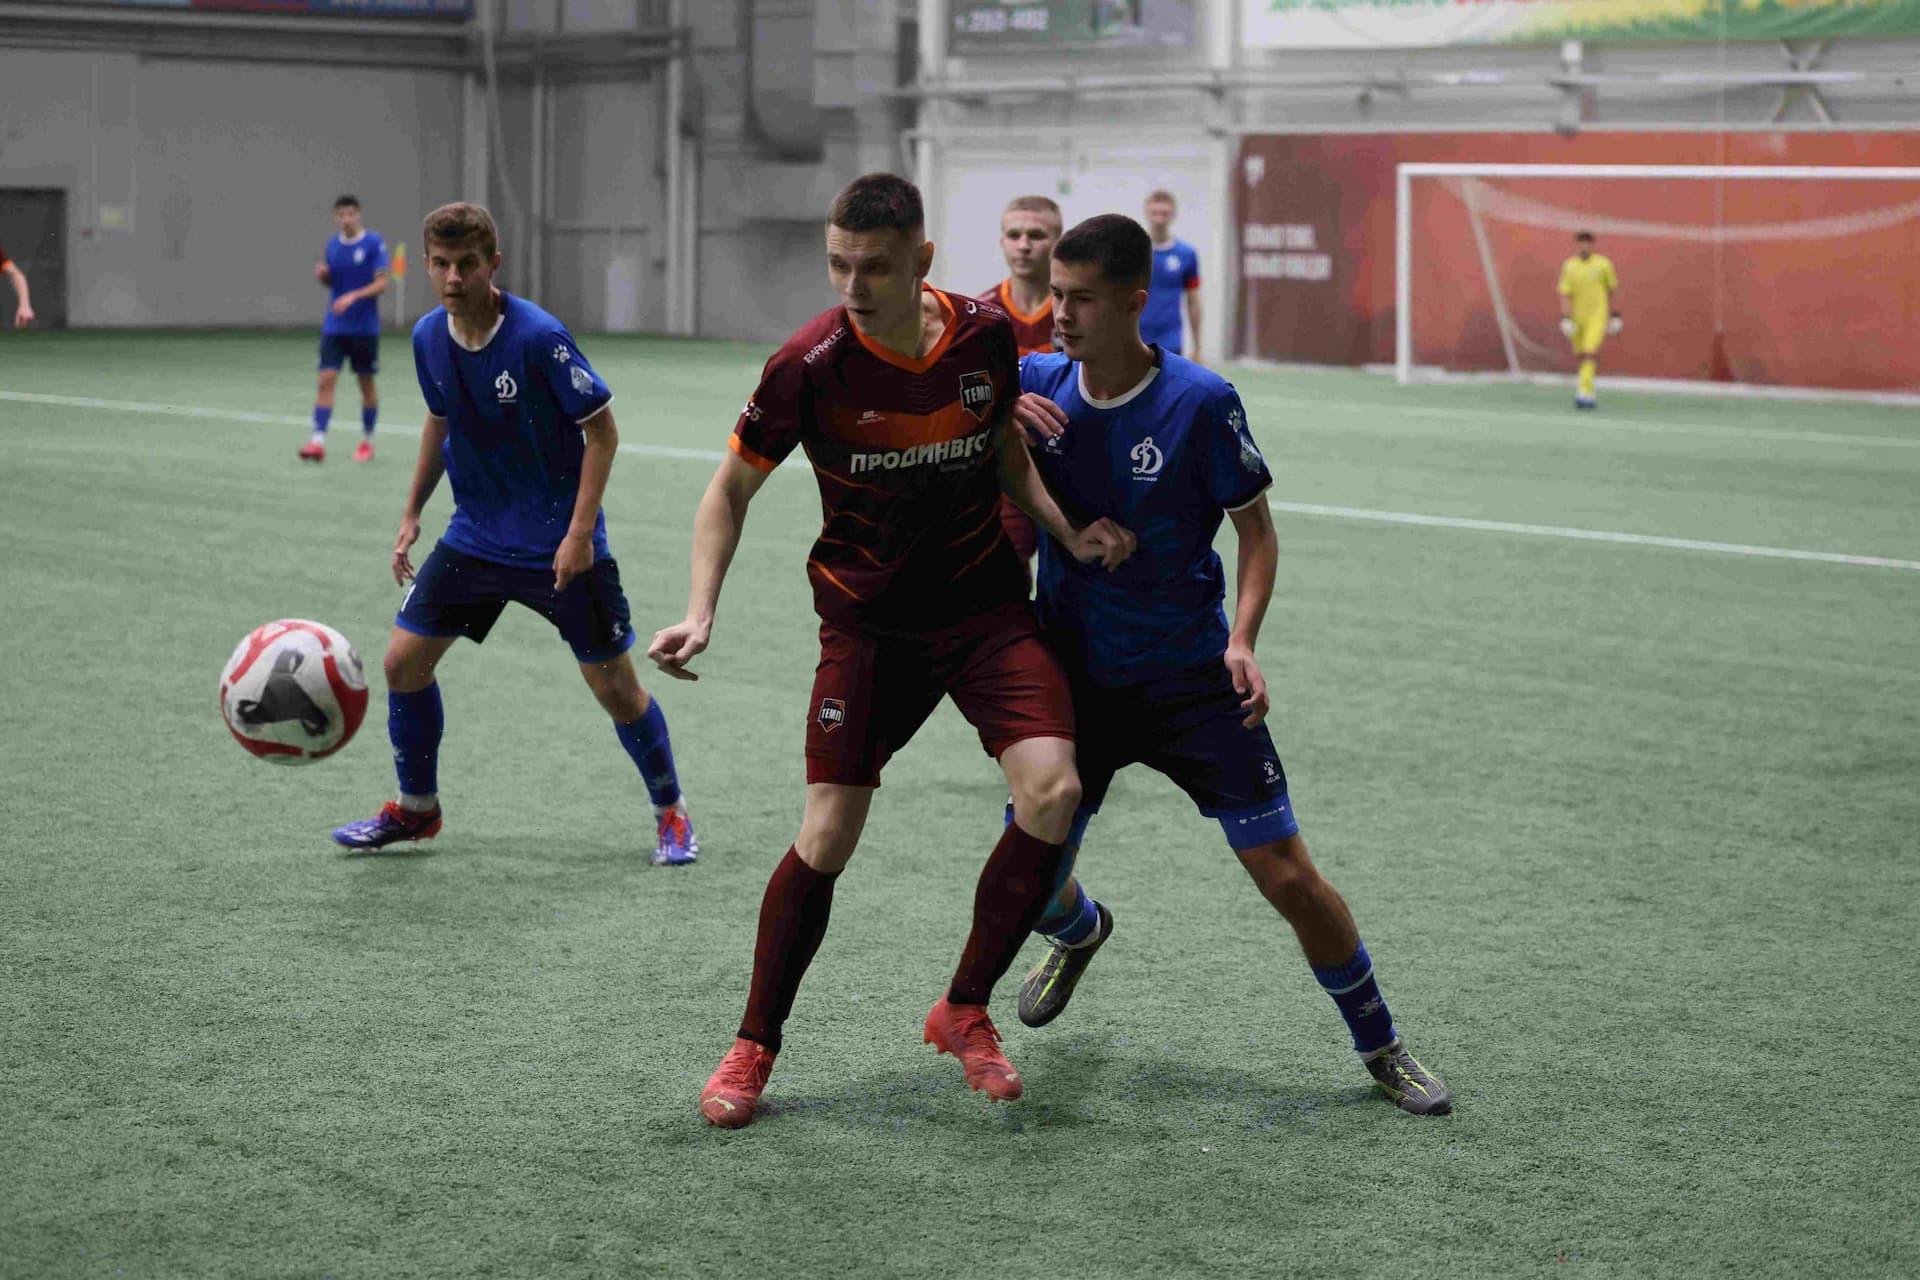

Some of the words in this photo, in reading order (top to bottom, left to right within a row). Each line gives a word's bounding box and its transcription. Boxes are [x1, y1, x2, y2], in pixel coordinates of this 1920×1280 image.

[963, 385, 992, 404] ТЕМП
[850, 428, 992, 475] ПРОДИНВЕС
[821, 708, 843, 722] ТЕМП
